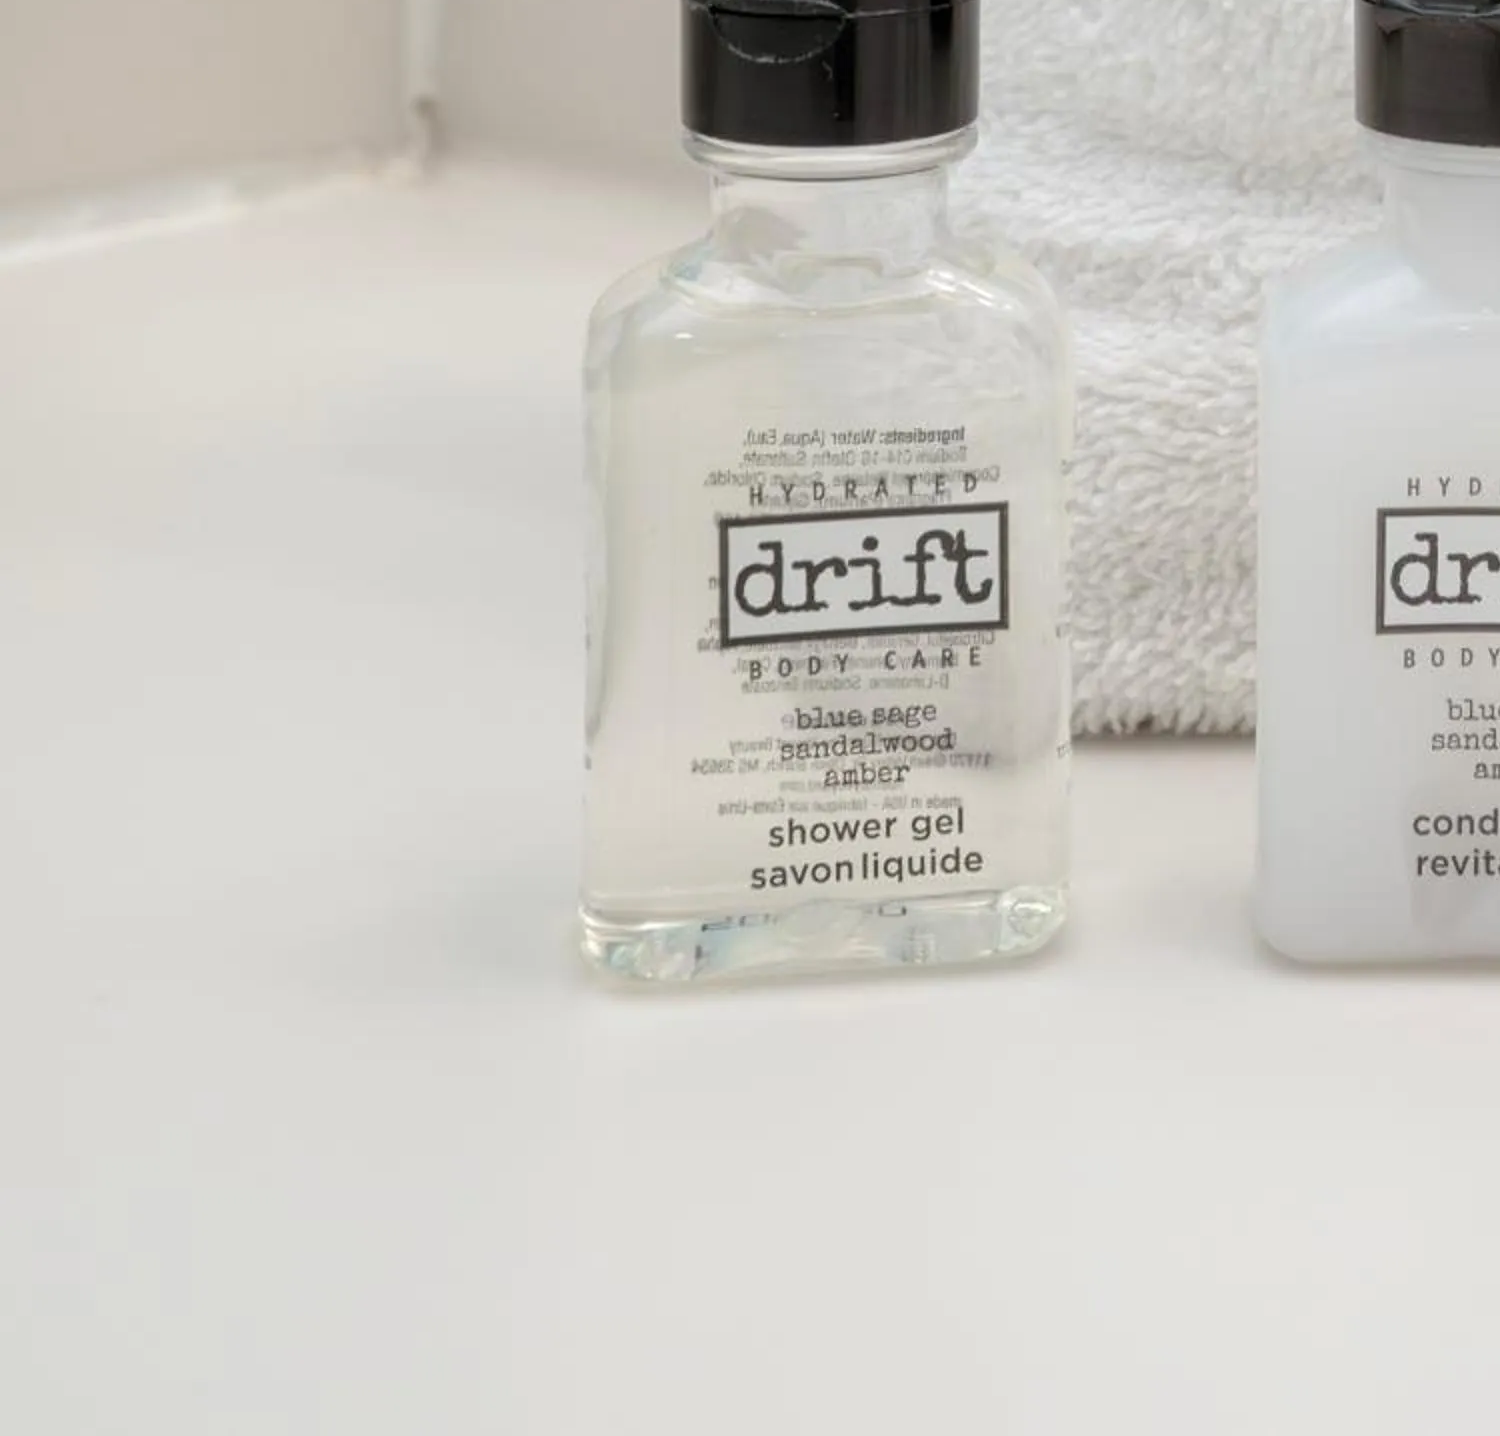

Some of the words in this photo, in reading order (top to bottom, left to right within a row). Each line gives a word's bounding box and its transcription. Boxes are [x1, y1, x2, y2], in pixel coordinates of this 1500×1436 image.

[749, 474, 979, 506] HYDRATED
[735, 529, 993, 617] drift
[749, 651, 849, 681] BODY
[885, 647, 982, 671] CARE
[795, 706, 864, 731] blue
[872, 702, 938, 728] sage
[779, 730, 956, 763] sandalwood
[823, 762, 912, 788] amber
[768, 813, 898, 847] shower
[911, 807, 966, 840] gel
[750, 860, 855, 890] savon
[861, 847, 984, 882] liquide
